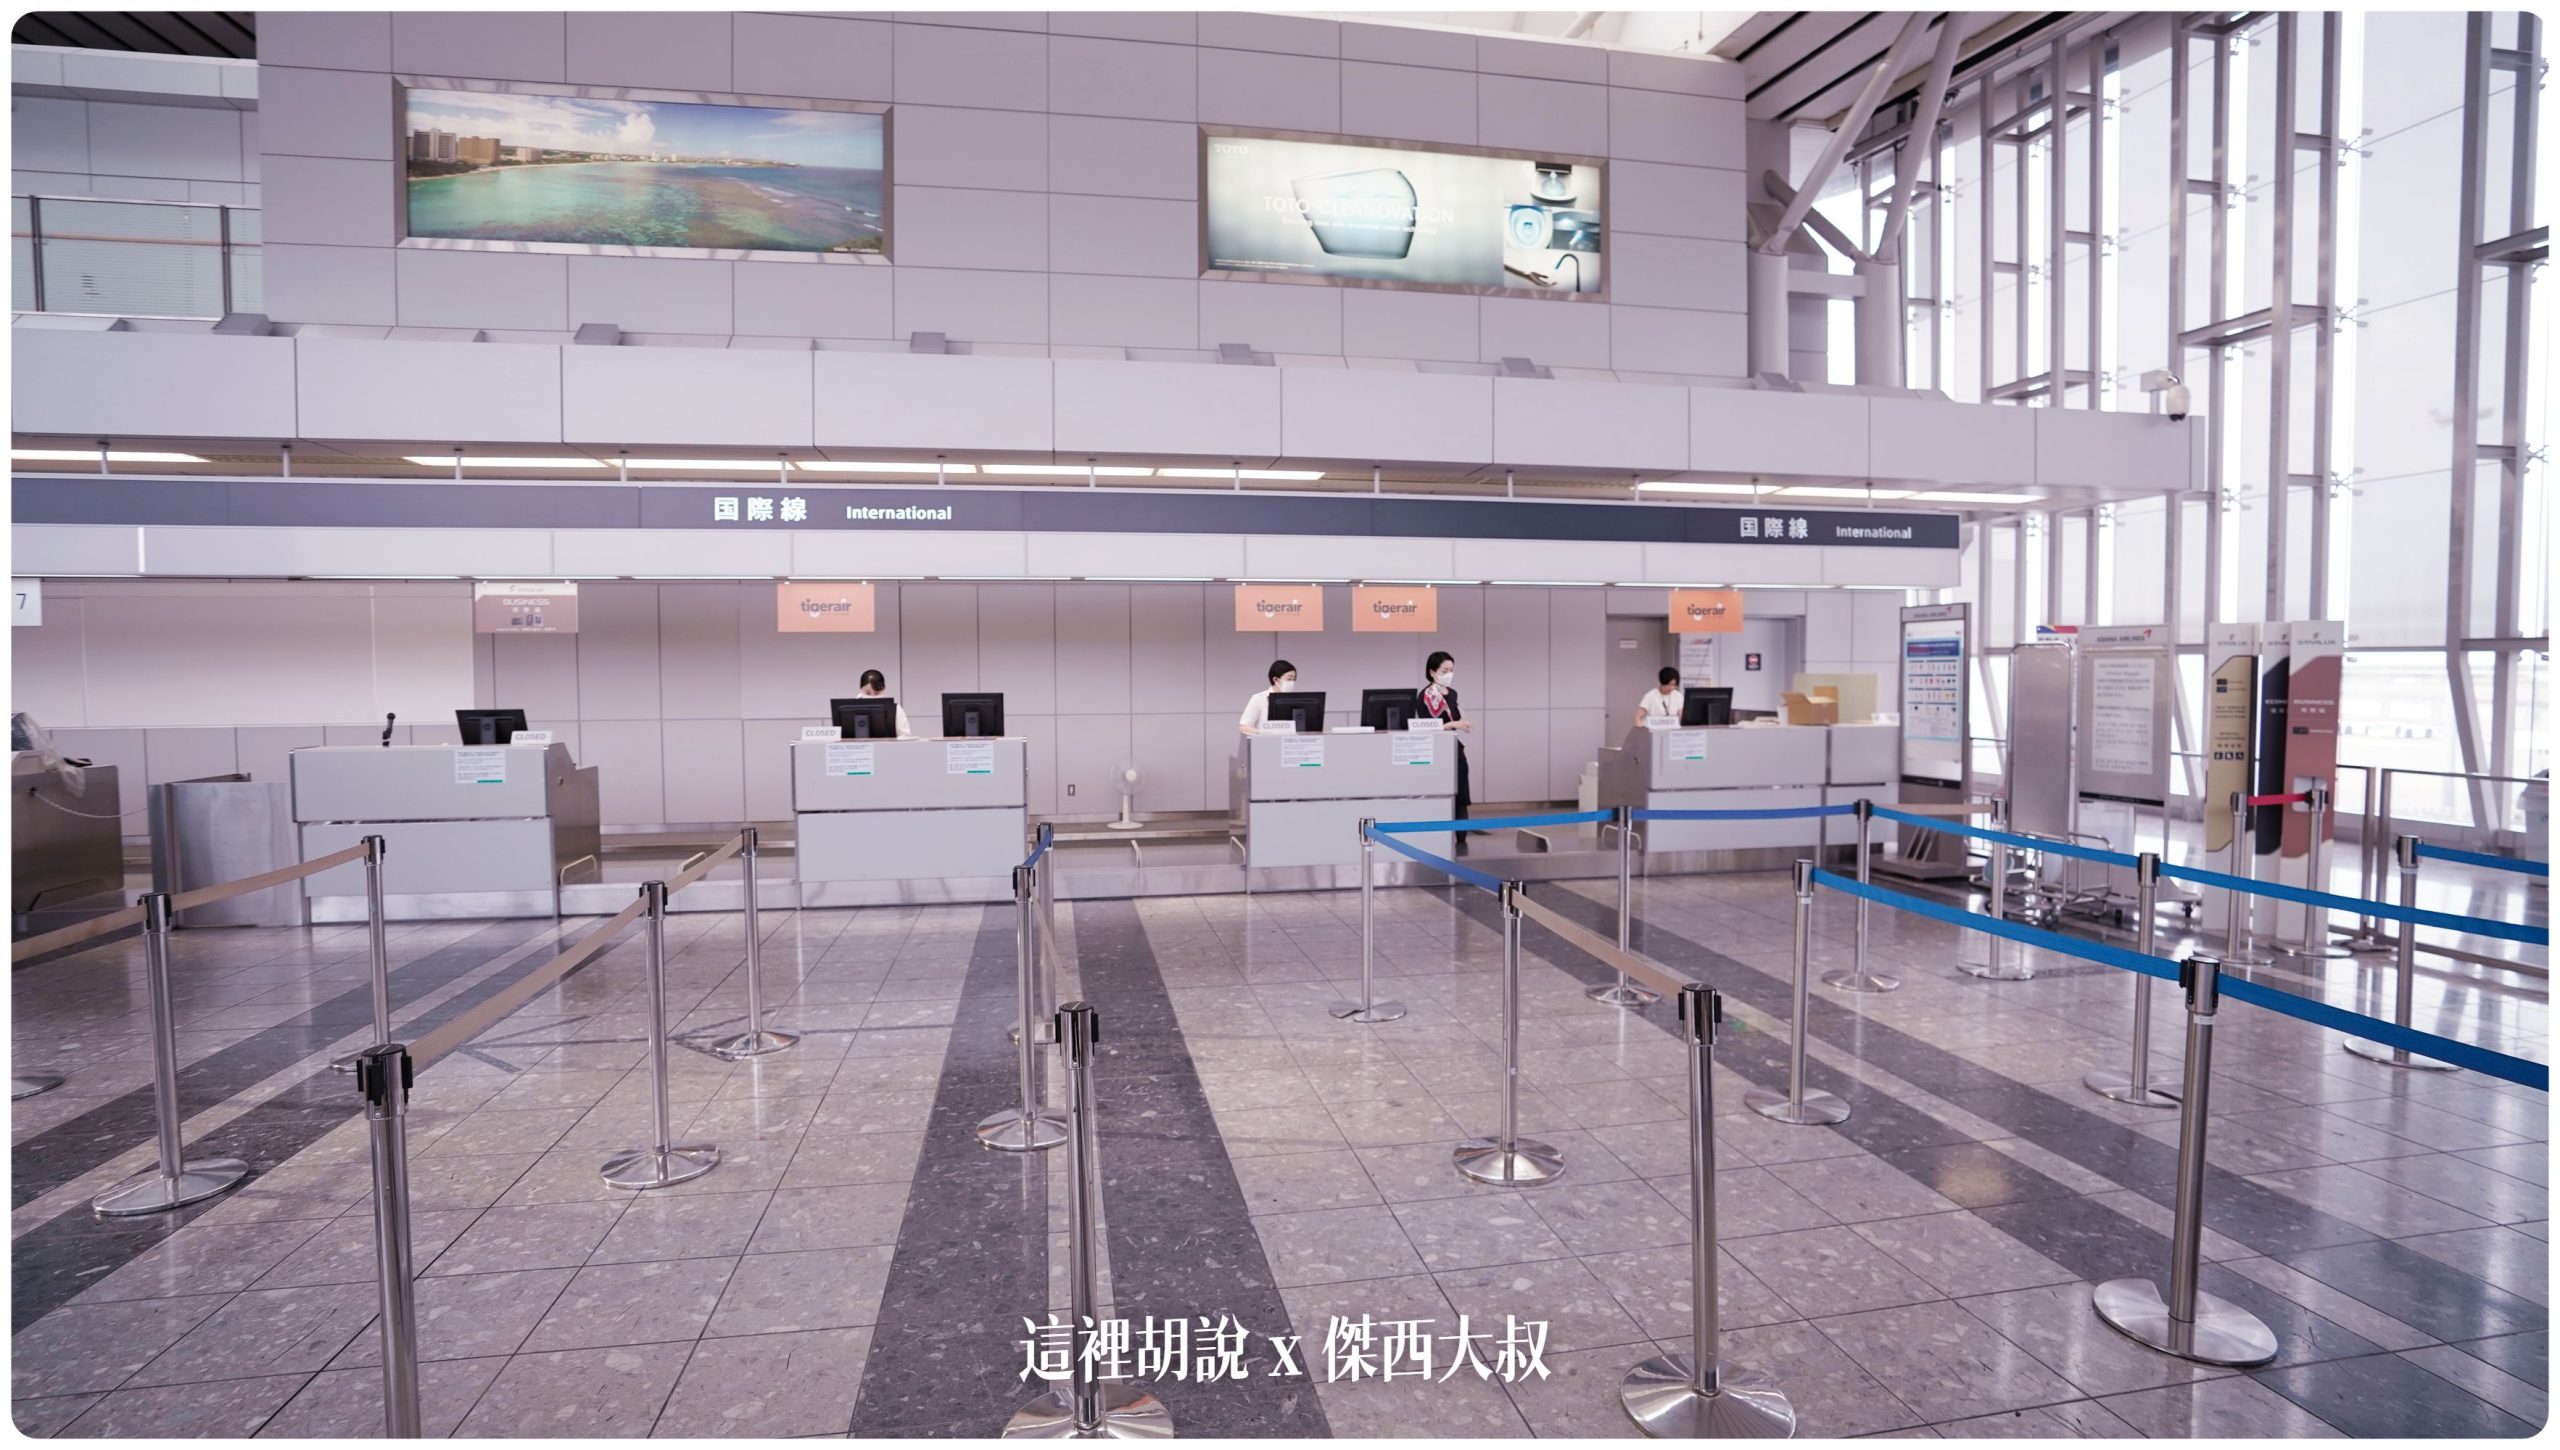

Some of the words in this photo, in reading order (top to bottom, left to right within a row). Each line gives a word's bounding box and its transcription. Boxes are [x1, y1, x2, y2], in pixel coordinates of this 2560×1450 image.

[1263, 196, 1311, 214] TOTO
[1319, 201, 1455, 223] CLEANOVATION
[714, 497, 807, 521] 国際線
[846, 506, 952, 520] International
[1740, 517, 1808, 539] 国際線
[1836, 525, 1912, 540] International
[16, 593, 26, 609] 7
[800, 598, 852, 617] tigerair
[1256, 600, 1303, 617] tigerair
[1373, 601, 1418, 618] tigerair
[1687, 603, 1726, 620] tigerair
[805, 729, 836, 737] CLOSED
[1263, 722, 1291, 730] CLOSED
[1412, 721, 1439, 729] CLOSED
[515, 733, 546, 741] CLOSED
